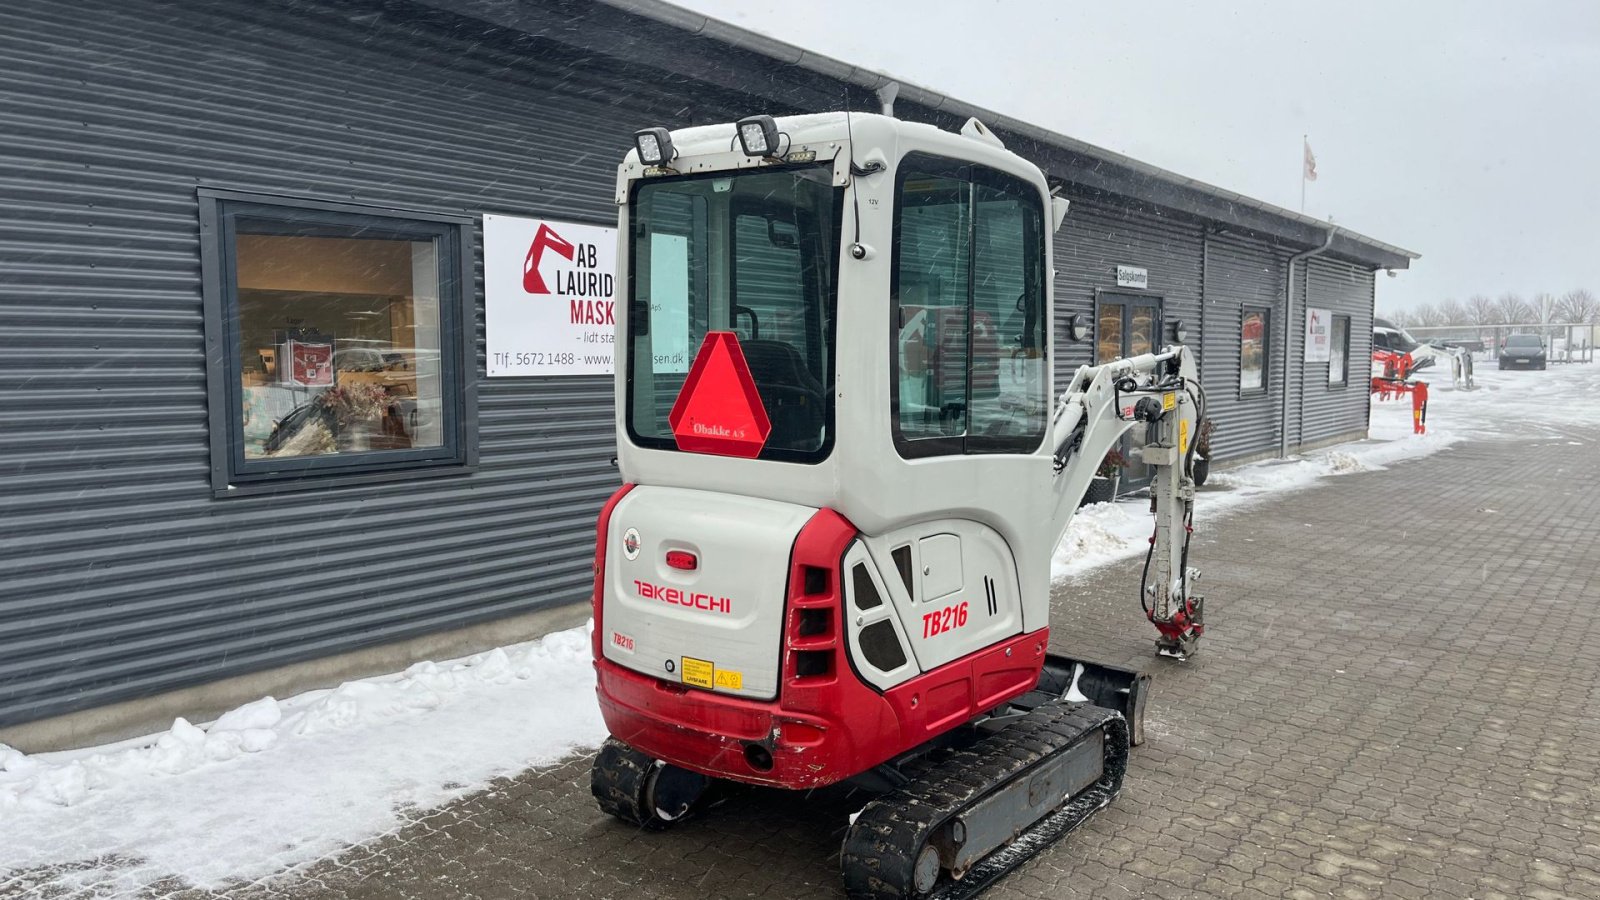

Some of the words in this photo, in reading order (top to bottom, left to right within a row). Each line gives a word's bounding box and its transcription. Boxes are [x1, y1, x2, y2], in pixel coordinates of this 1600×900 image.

[576, 243, 597, 269] AB
[556, 269, 615, 298] LAURID
[570, 299, 615, 325] MASK
[583, 331, 599, 343] lidt
[494, 352, 513, 369] Tlf.
[516, 352, 545, 366] 5672
[547, 352, 575, 366] 1488
[693, 422, 731, 437] Øbakke
[922, 601, 969, 639] TB216
[613, 632, 634, 650] TB216
